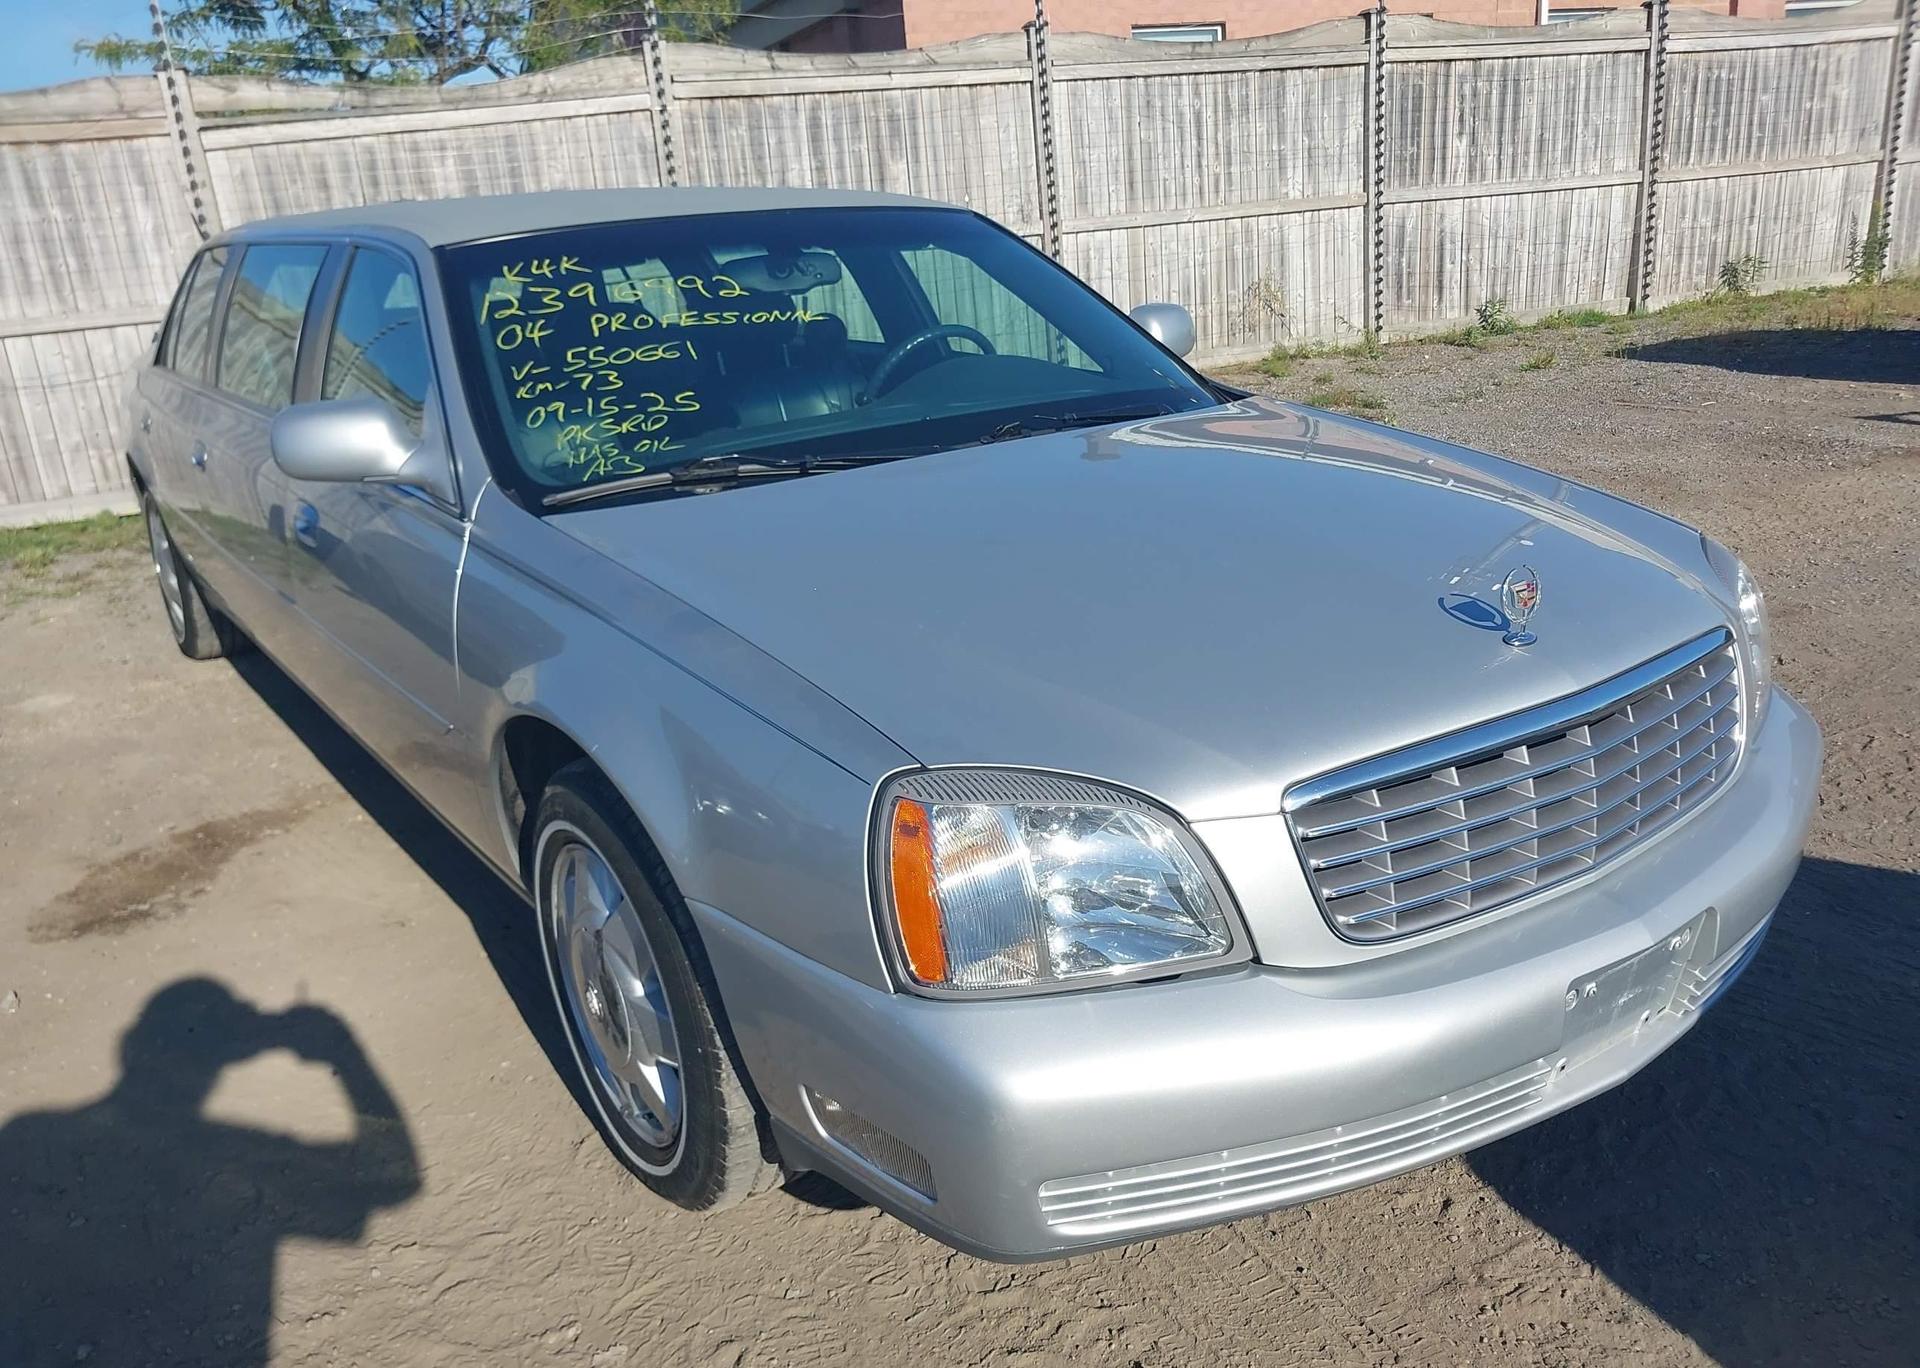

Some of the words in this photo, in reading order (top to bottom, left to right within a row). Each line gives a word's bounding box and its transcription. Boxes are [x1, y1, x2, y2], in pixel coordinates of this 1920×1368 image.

[496, 319, 555, 350] 04
[590, 309, 830, 338] PROFESSIONAL
[526, 391, 701, 429] 09-15-25
